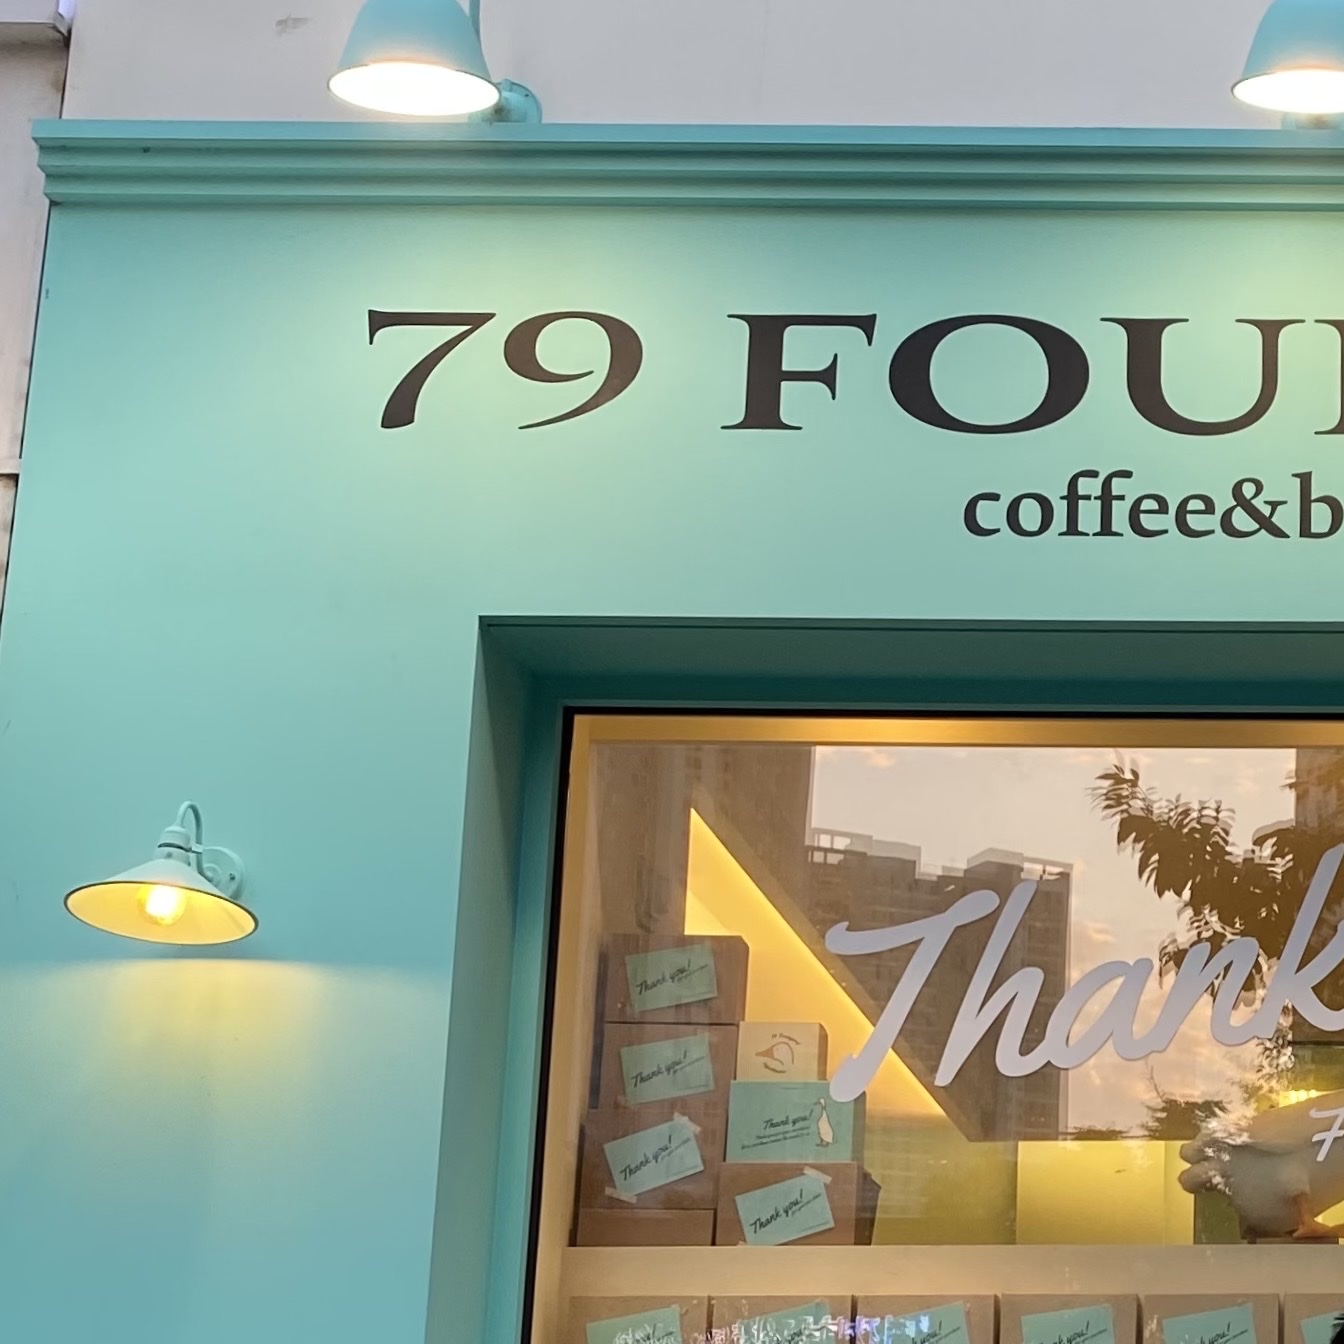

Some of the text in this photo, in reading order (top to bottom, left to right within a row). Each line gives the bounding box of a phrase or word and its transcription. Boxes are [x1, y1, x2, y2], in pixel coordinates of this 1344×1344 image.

[368, 309, 643, 430] 79
[635, 975, 667, 995] Thank
[669, 959, 692, 982] you!
[631, 1067, 665, 1088] Thank
[665, 1051, 687, 1074] you!
[620, 1154, 651, 1181] Thank
[651, 1134, 672, 1165] you!
[750, 1208, 781, 1234] Thank
[782, 1188, 804, 1217] you!
